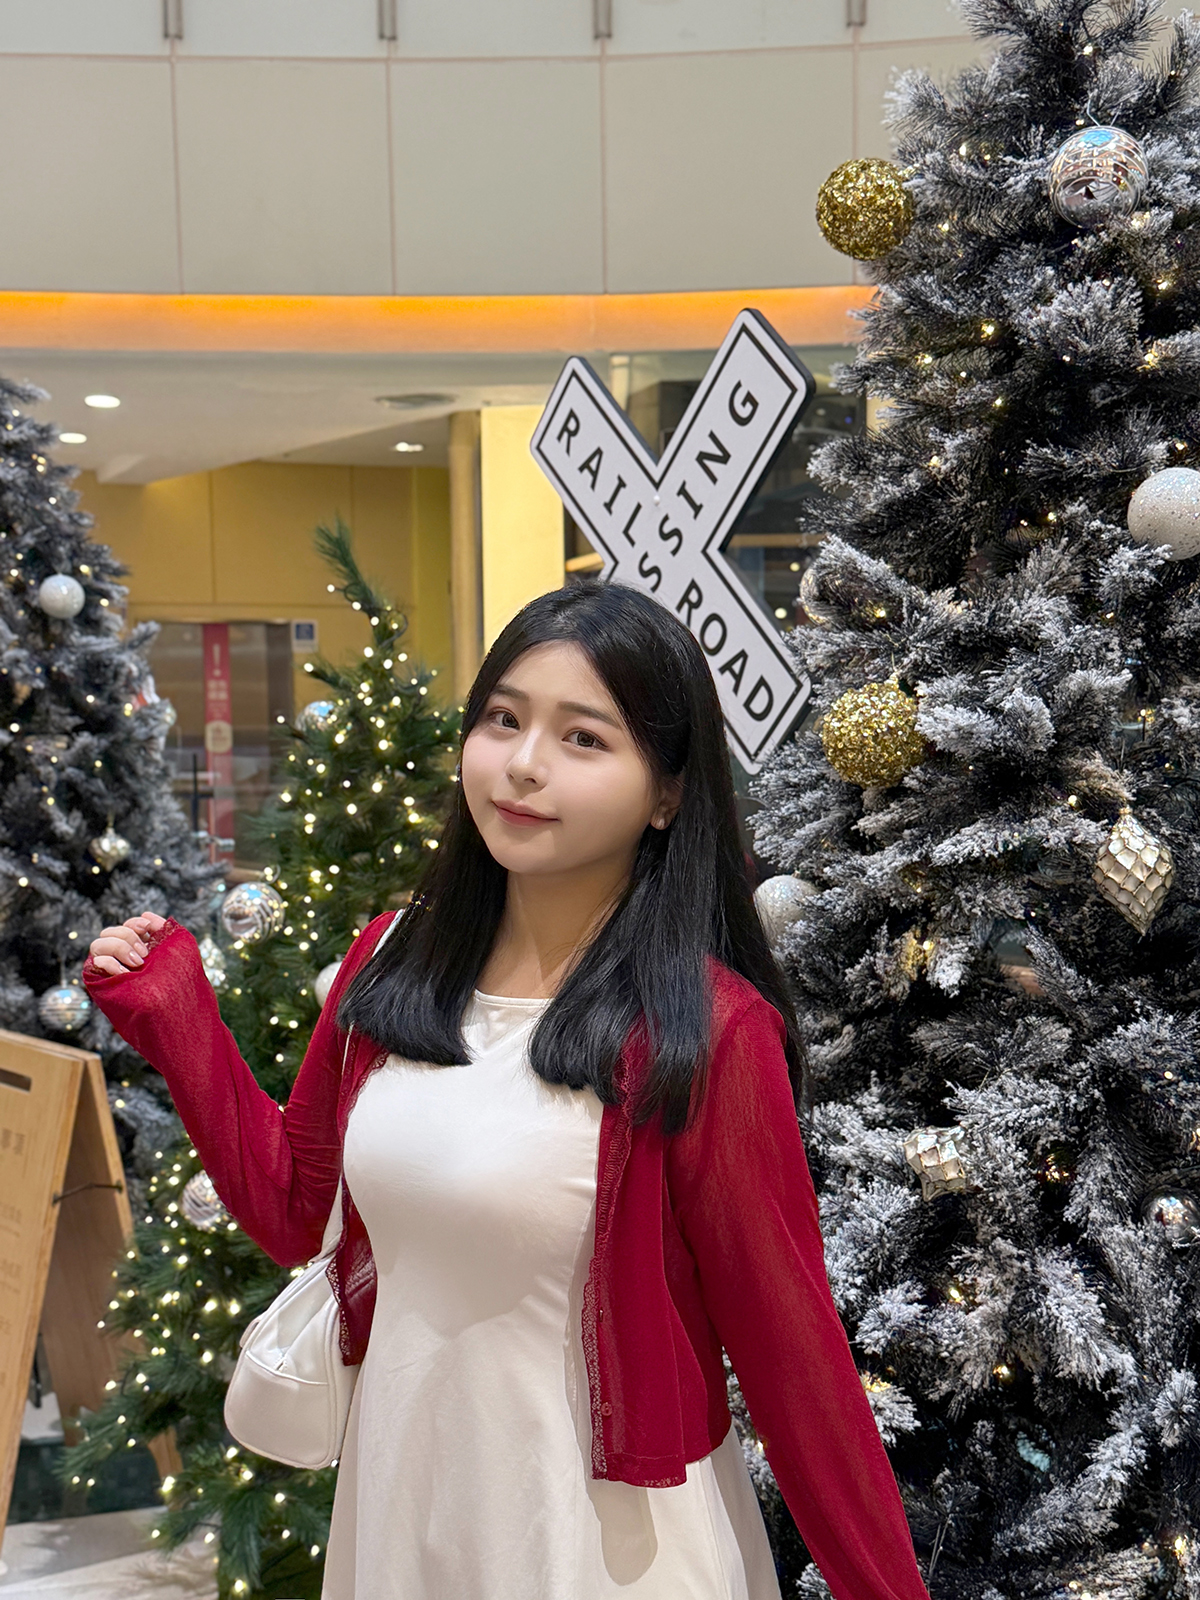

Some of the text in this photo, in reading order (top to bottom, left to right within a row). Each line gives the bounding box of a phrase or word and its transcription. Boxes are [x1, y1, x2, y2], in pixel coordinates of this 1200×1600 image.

[557, 408, 774, 721] RAIL ROAD
[638, 380, 759, 593] SSING
